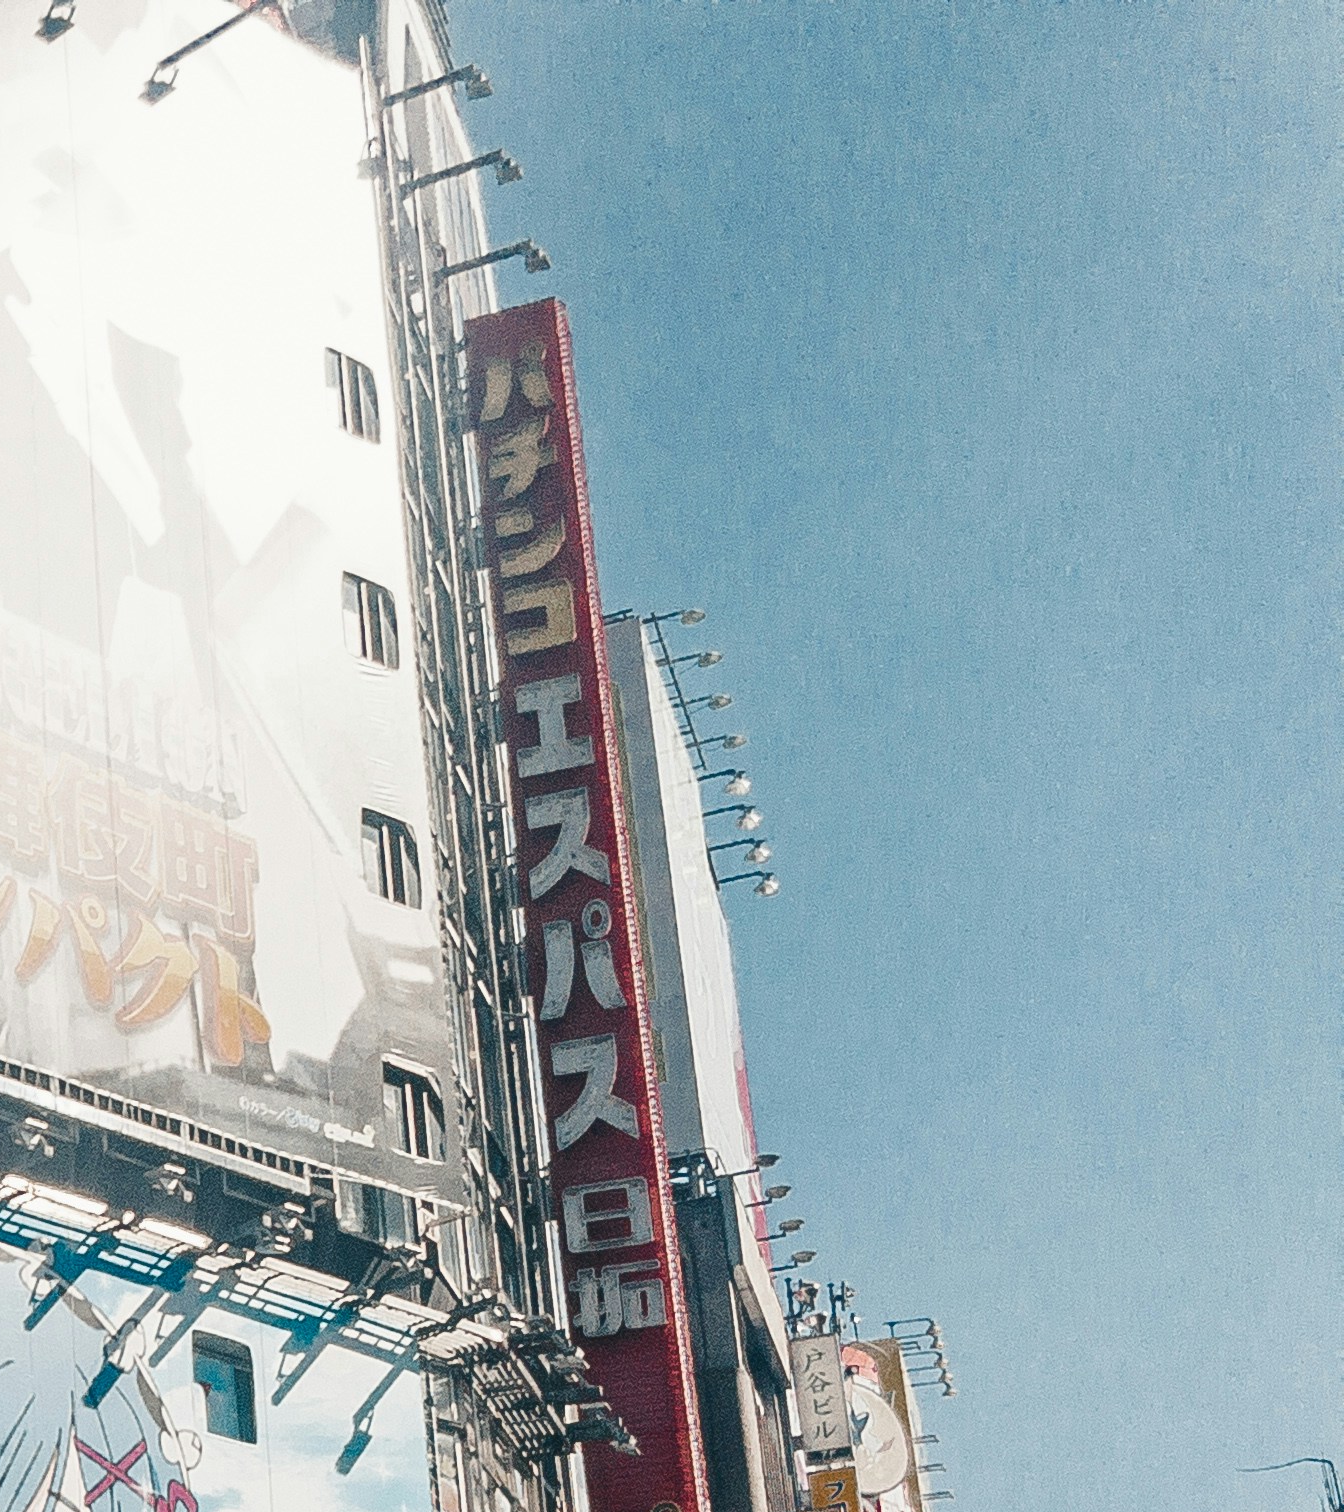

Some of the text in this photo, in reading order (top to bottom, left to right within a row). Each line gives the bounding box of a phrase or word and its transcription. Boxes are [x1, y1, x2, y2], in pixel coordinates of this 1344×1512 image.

[480, 339, 669, 1340] パチンコ エスパス 日拓
[803, 1348, 838, 1440] 戸谷ビル
